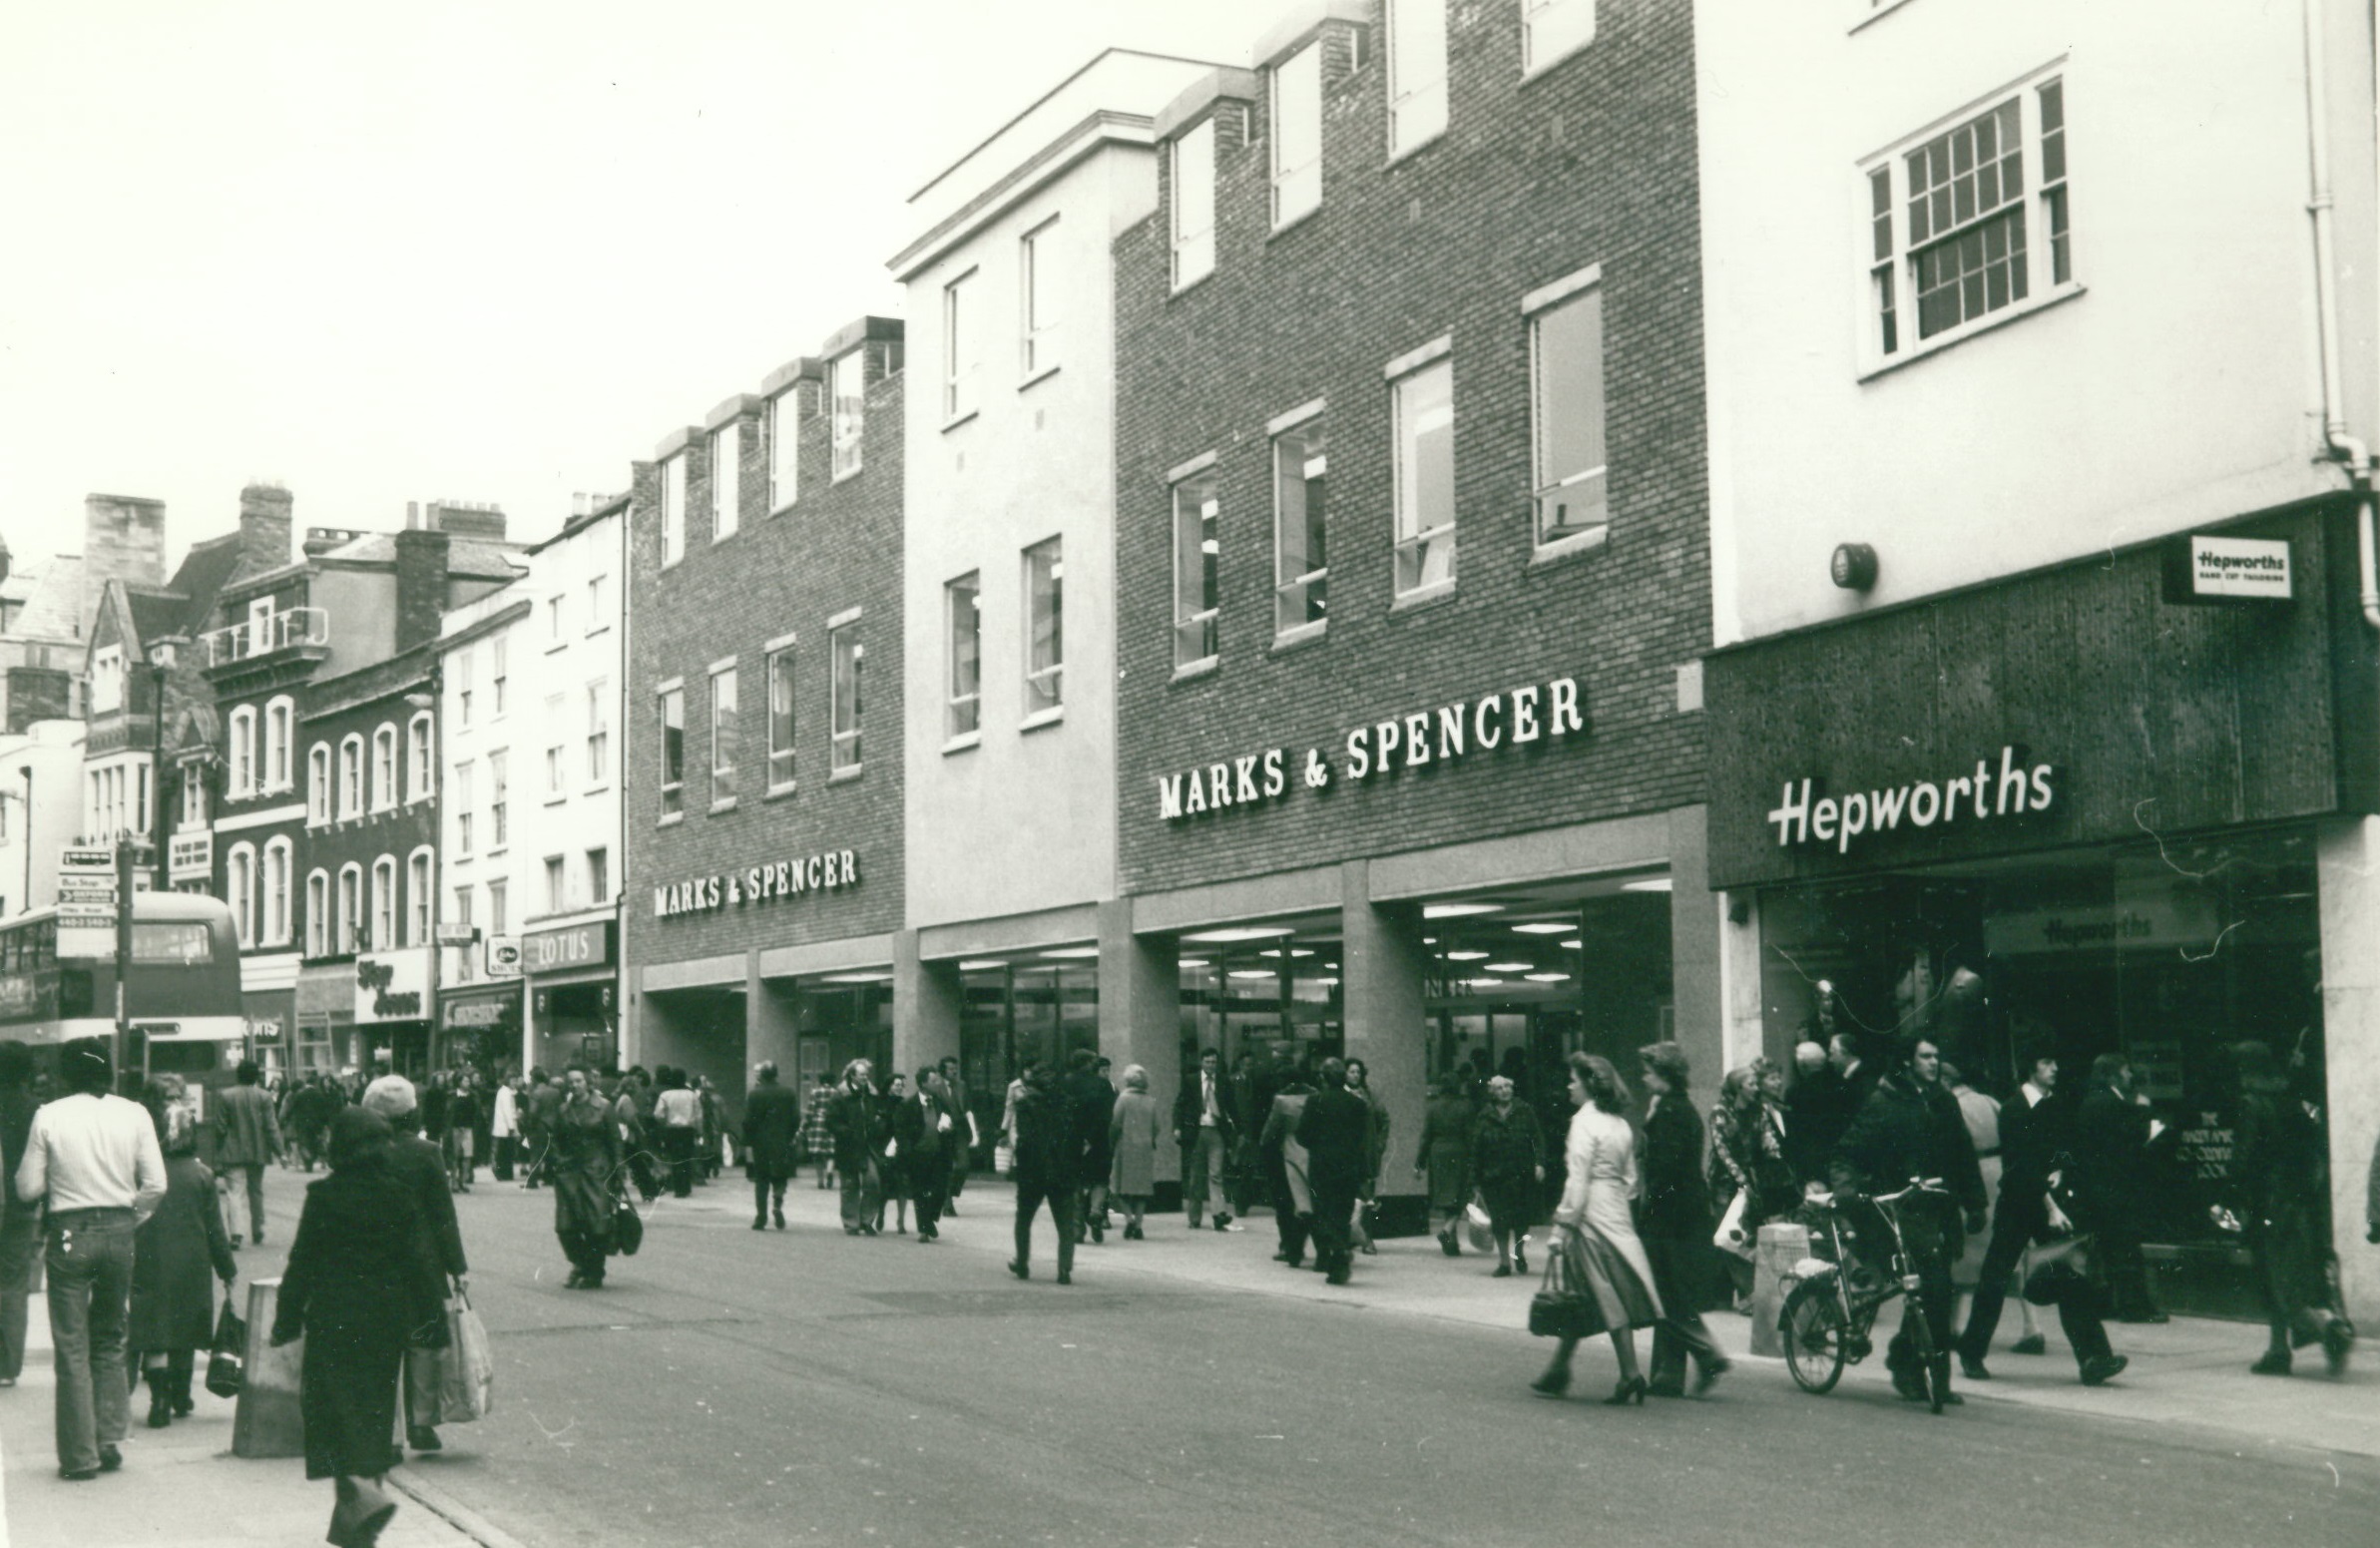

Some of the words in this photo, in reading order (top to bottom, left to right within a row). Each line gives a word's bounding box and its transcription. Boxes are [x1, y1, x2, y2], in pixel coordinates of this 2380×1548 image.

[2197, 551, 2284, 571] Hepworths
[1159, 749, 1285, 819] MARKS
[1304, 748, 1328, 787] &
[1347, 678, 1584, 779] SPENCER
[1767, 746, 2053, 853] Hepworths
[655, 876, 719, 916] MARKS
[728, 876, 740, 903] &
[748, 849, 856, 899] SPENCER
[539, 931, 589, 965] LOTUS
[2043, 912, 2151, 947] Hepworths
